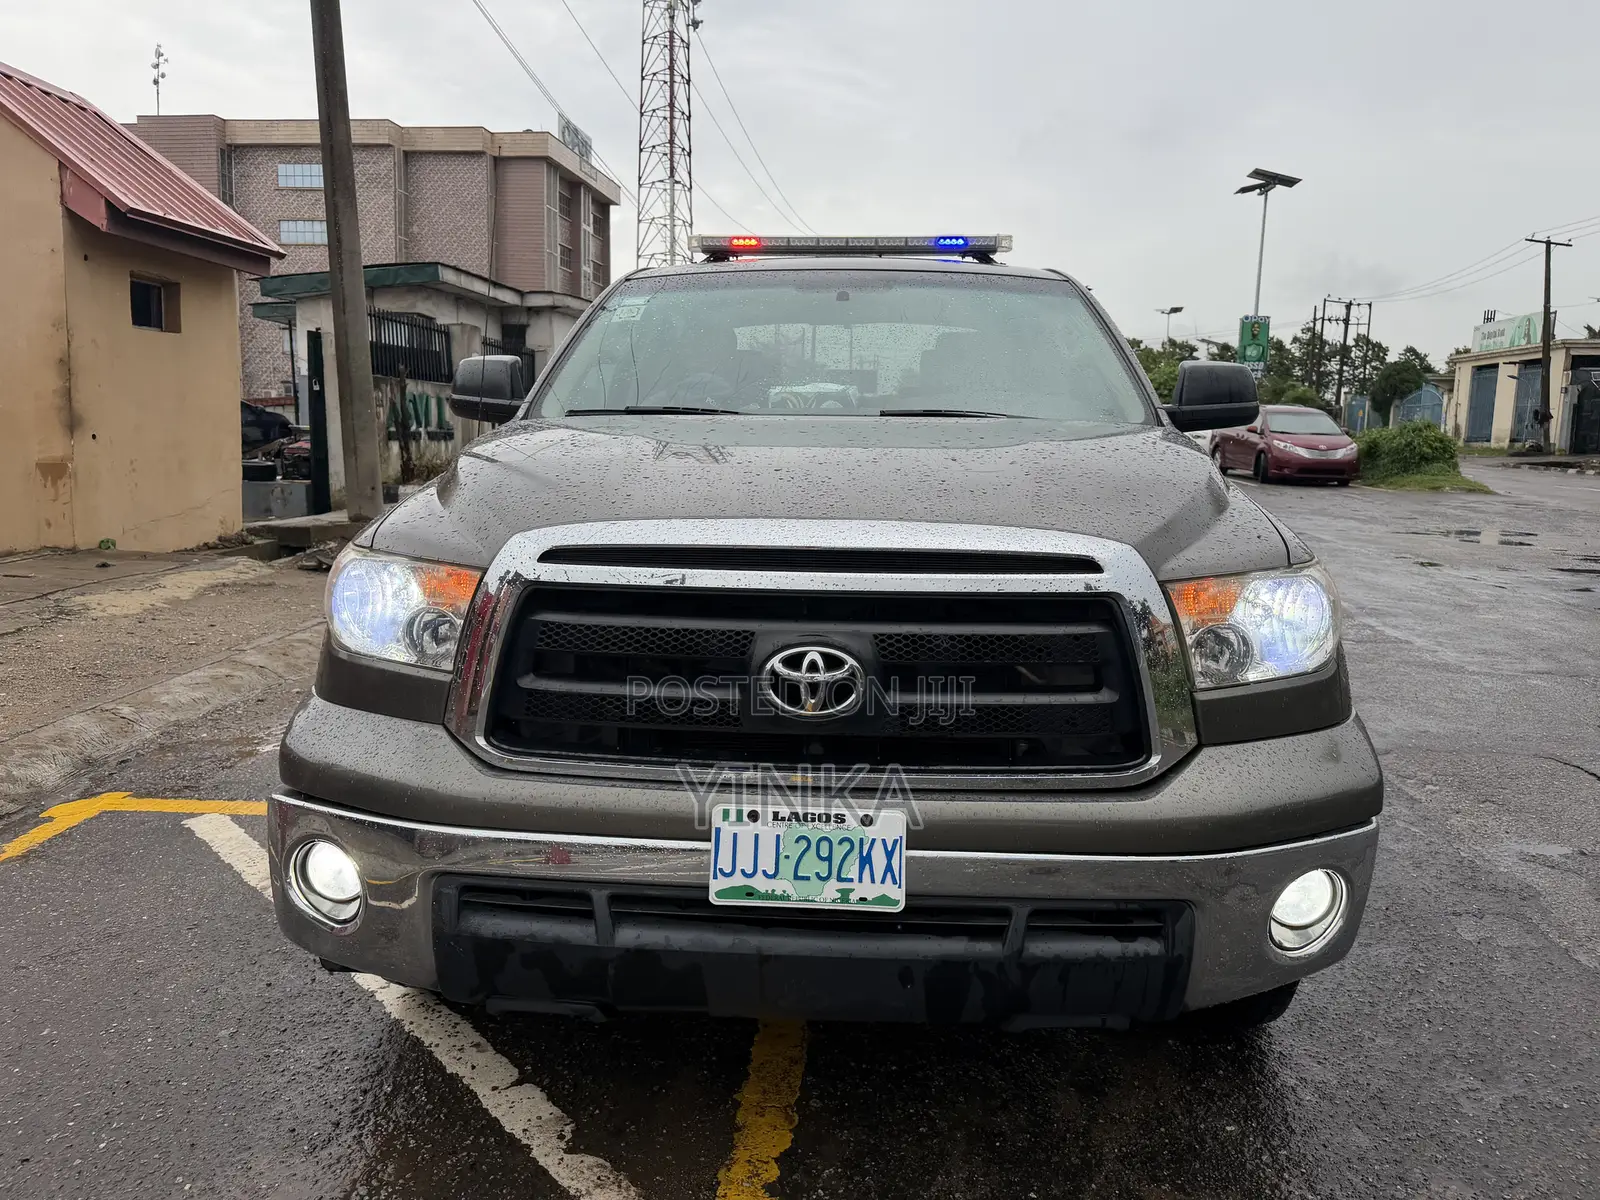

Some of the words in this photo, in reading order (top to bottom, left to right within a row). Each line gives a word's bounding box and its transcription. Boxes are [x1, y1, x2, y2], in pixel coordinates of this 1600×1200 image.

[1243, 315, 1270, 324] OPay
[772, 811, 846, 824] LAGOS
[766, 821, 793, 829] CENTRE
